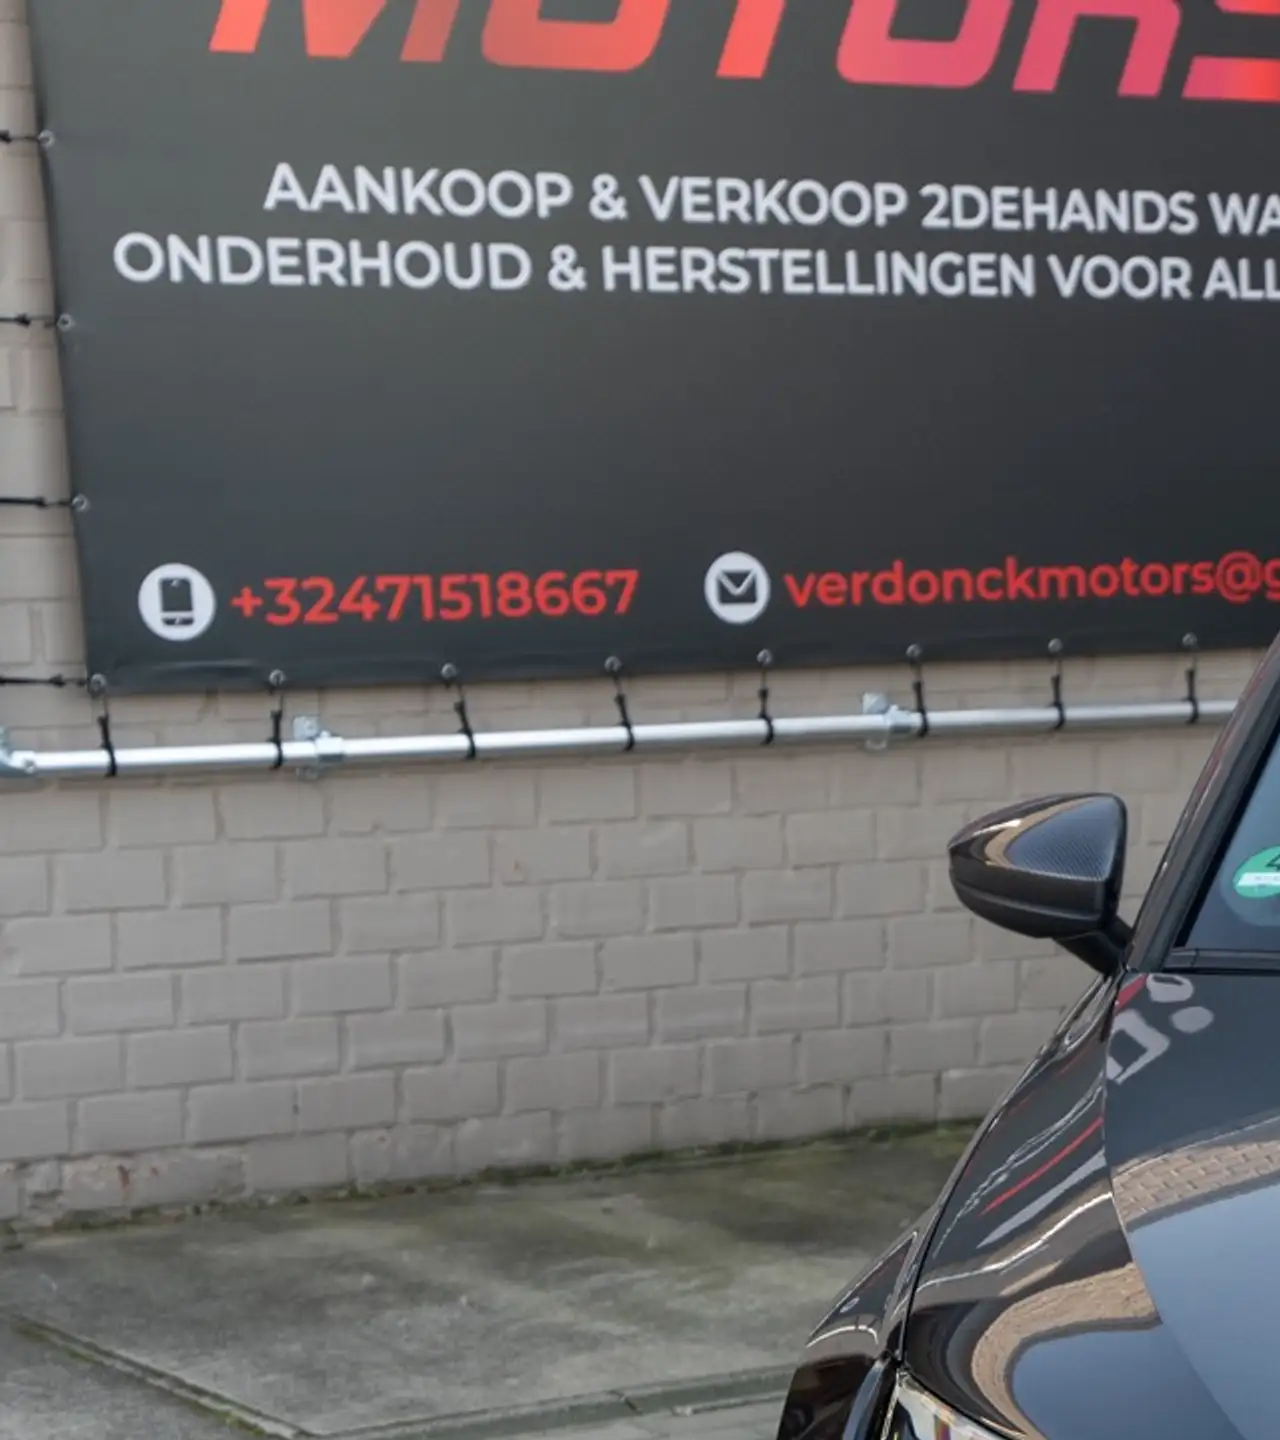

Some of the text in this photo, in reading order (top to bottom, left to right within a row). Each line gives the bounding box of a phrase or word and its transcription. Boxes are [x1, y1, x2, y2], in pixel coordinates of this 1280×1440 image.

[264, 162, 572, 218] AANKOOP
[590, 174, 627, 220] &
[639, 175, 907, 226] VERKOOP
[921, 184, 1197, 233] 2DEHANDS
[114, 233, 531, 289] ONDERHOUD
[548, 245, 586, 290] &
[603, 246, 1034, 296] HERSTELLINGEN
[1048, 255, 1191, 297] VOOR
[232, 569, 639, 625] +32471518667
